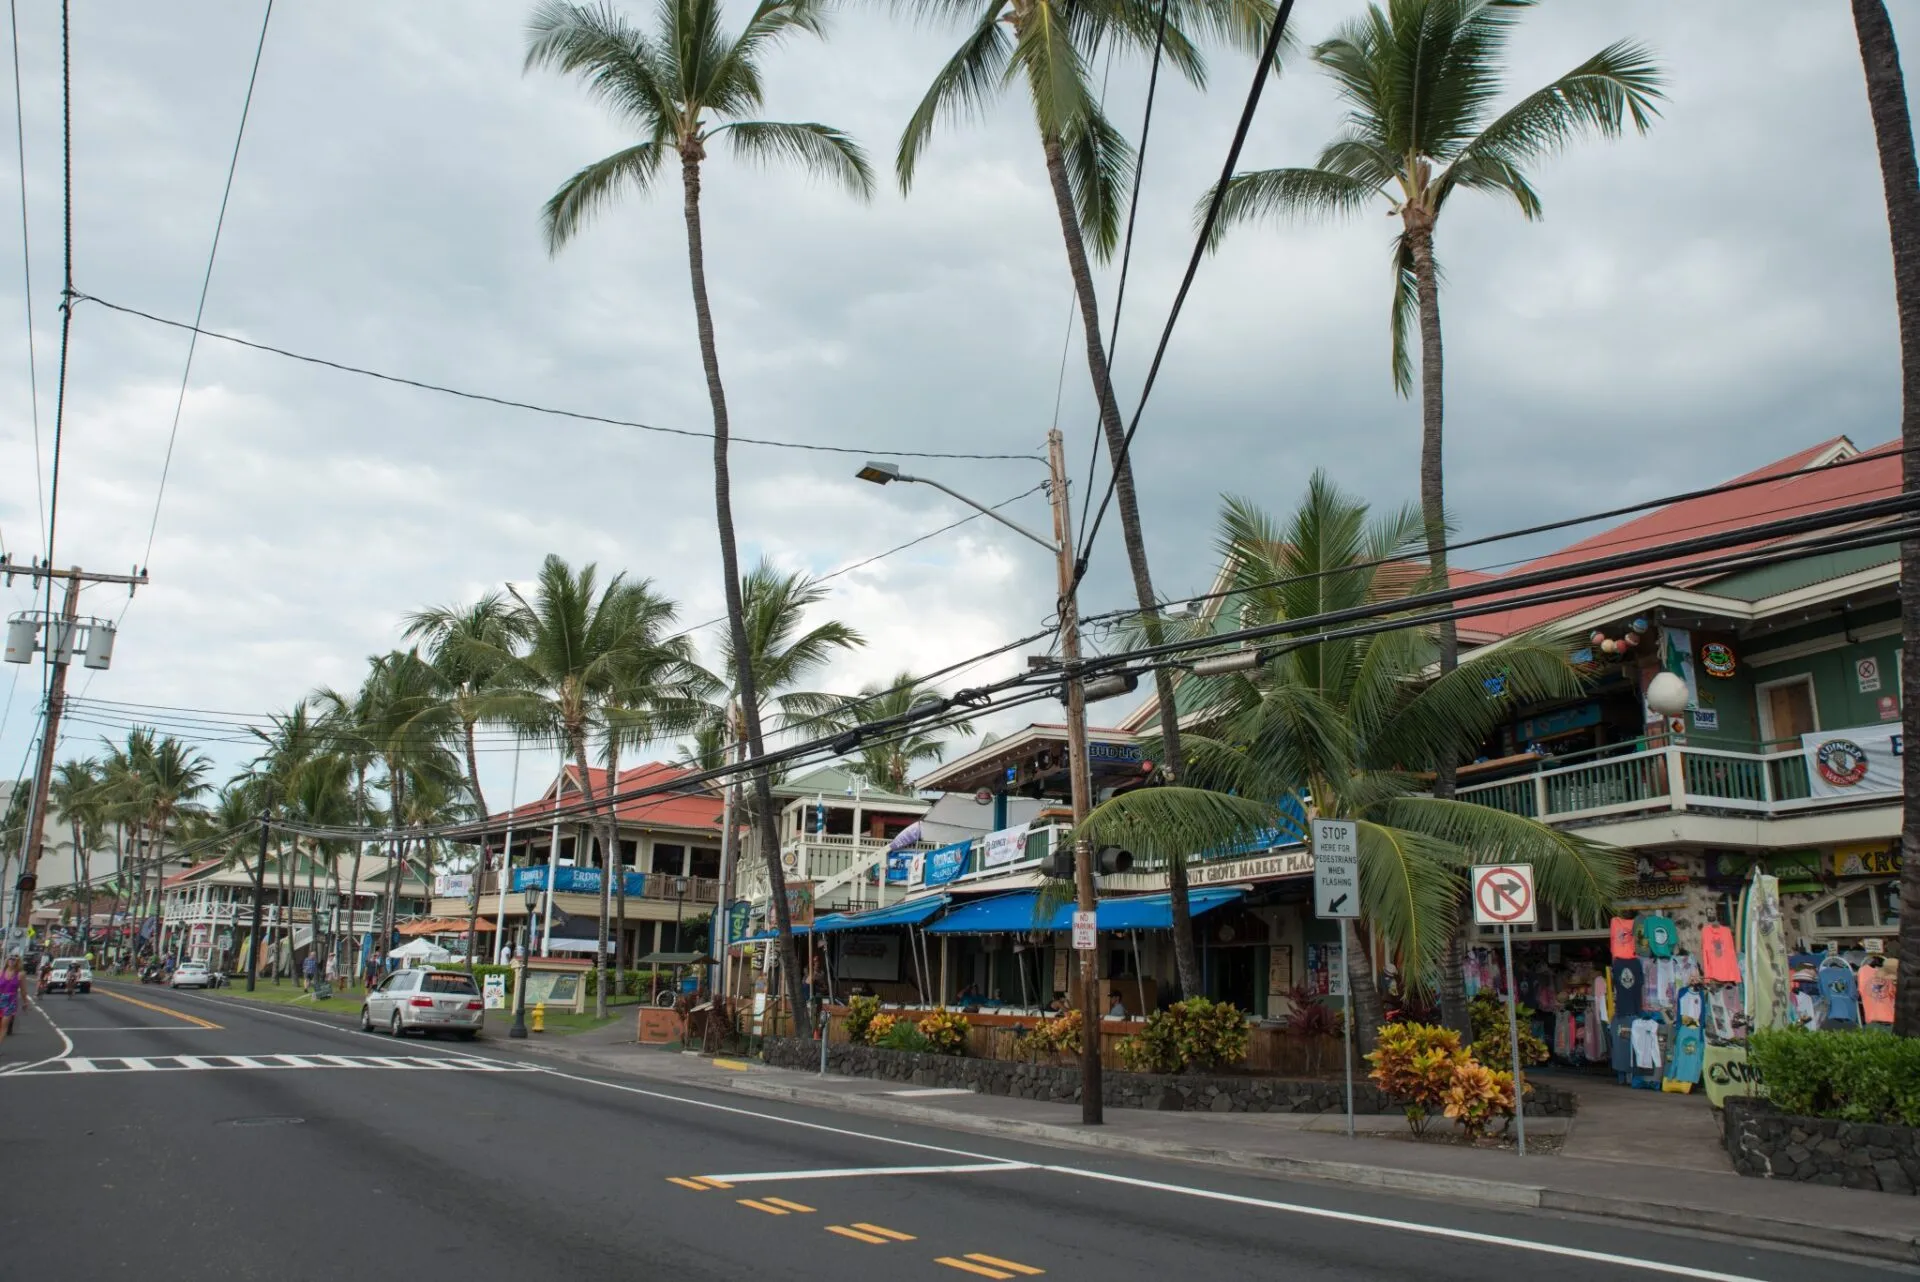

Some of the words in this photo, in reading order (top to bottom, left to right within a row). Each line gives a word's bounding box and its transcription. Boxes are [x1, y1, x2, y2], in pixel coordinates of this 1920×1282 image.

[1322, 826, 1348, 840] STOP
[1321, 844, 1336, 852] HERE
[1338, 844, 1350, 853] FOR
[1315, 855, 1357, 864] PEDESTRIANS
[1207, 866, 1235, 881] GROVE
[1239, 859, 1283, 876] MARKET
[1286, 854, 1314, 872] PLAC
[1328, 867, 1345, 875] WHEN
[573, 870, 617, 885] ERDINR
[1322, 878, 1352, 887] FLASHING
